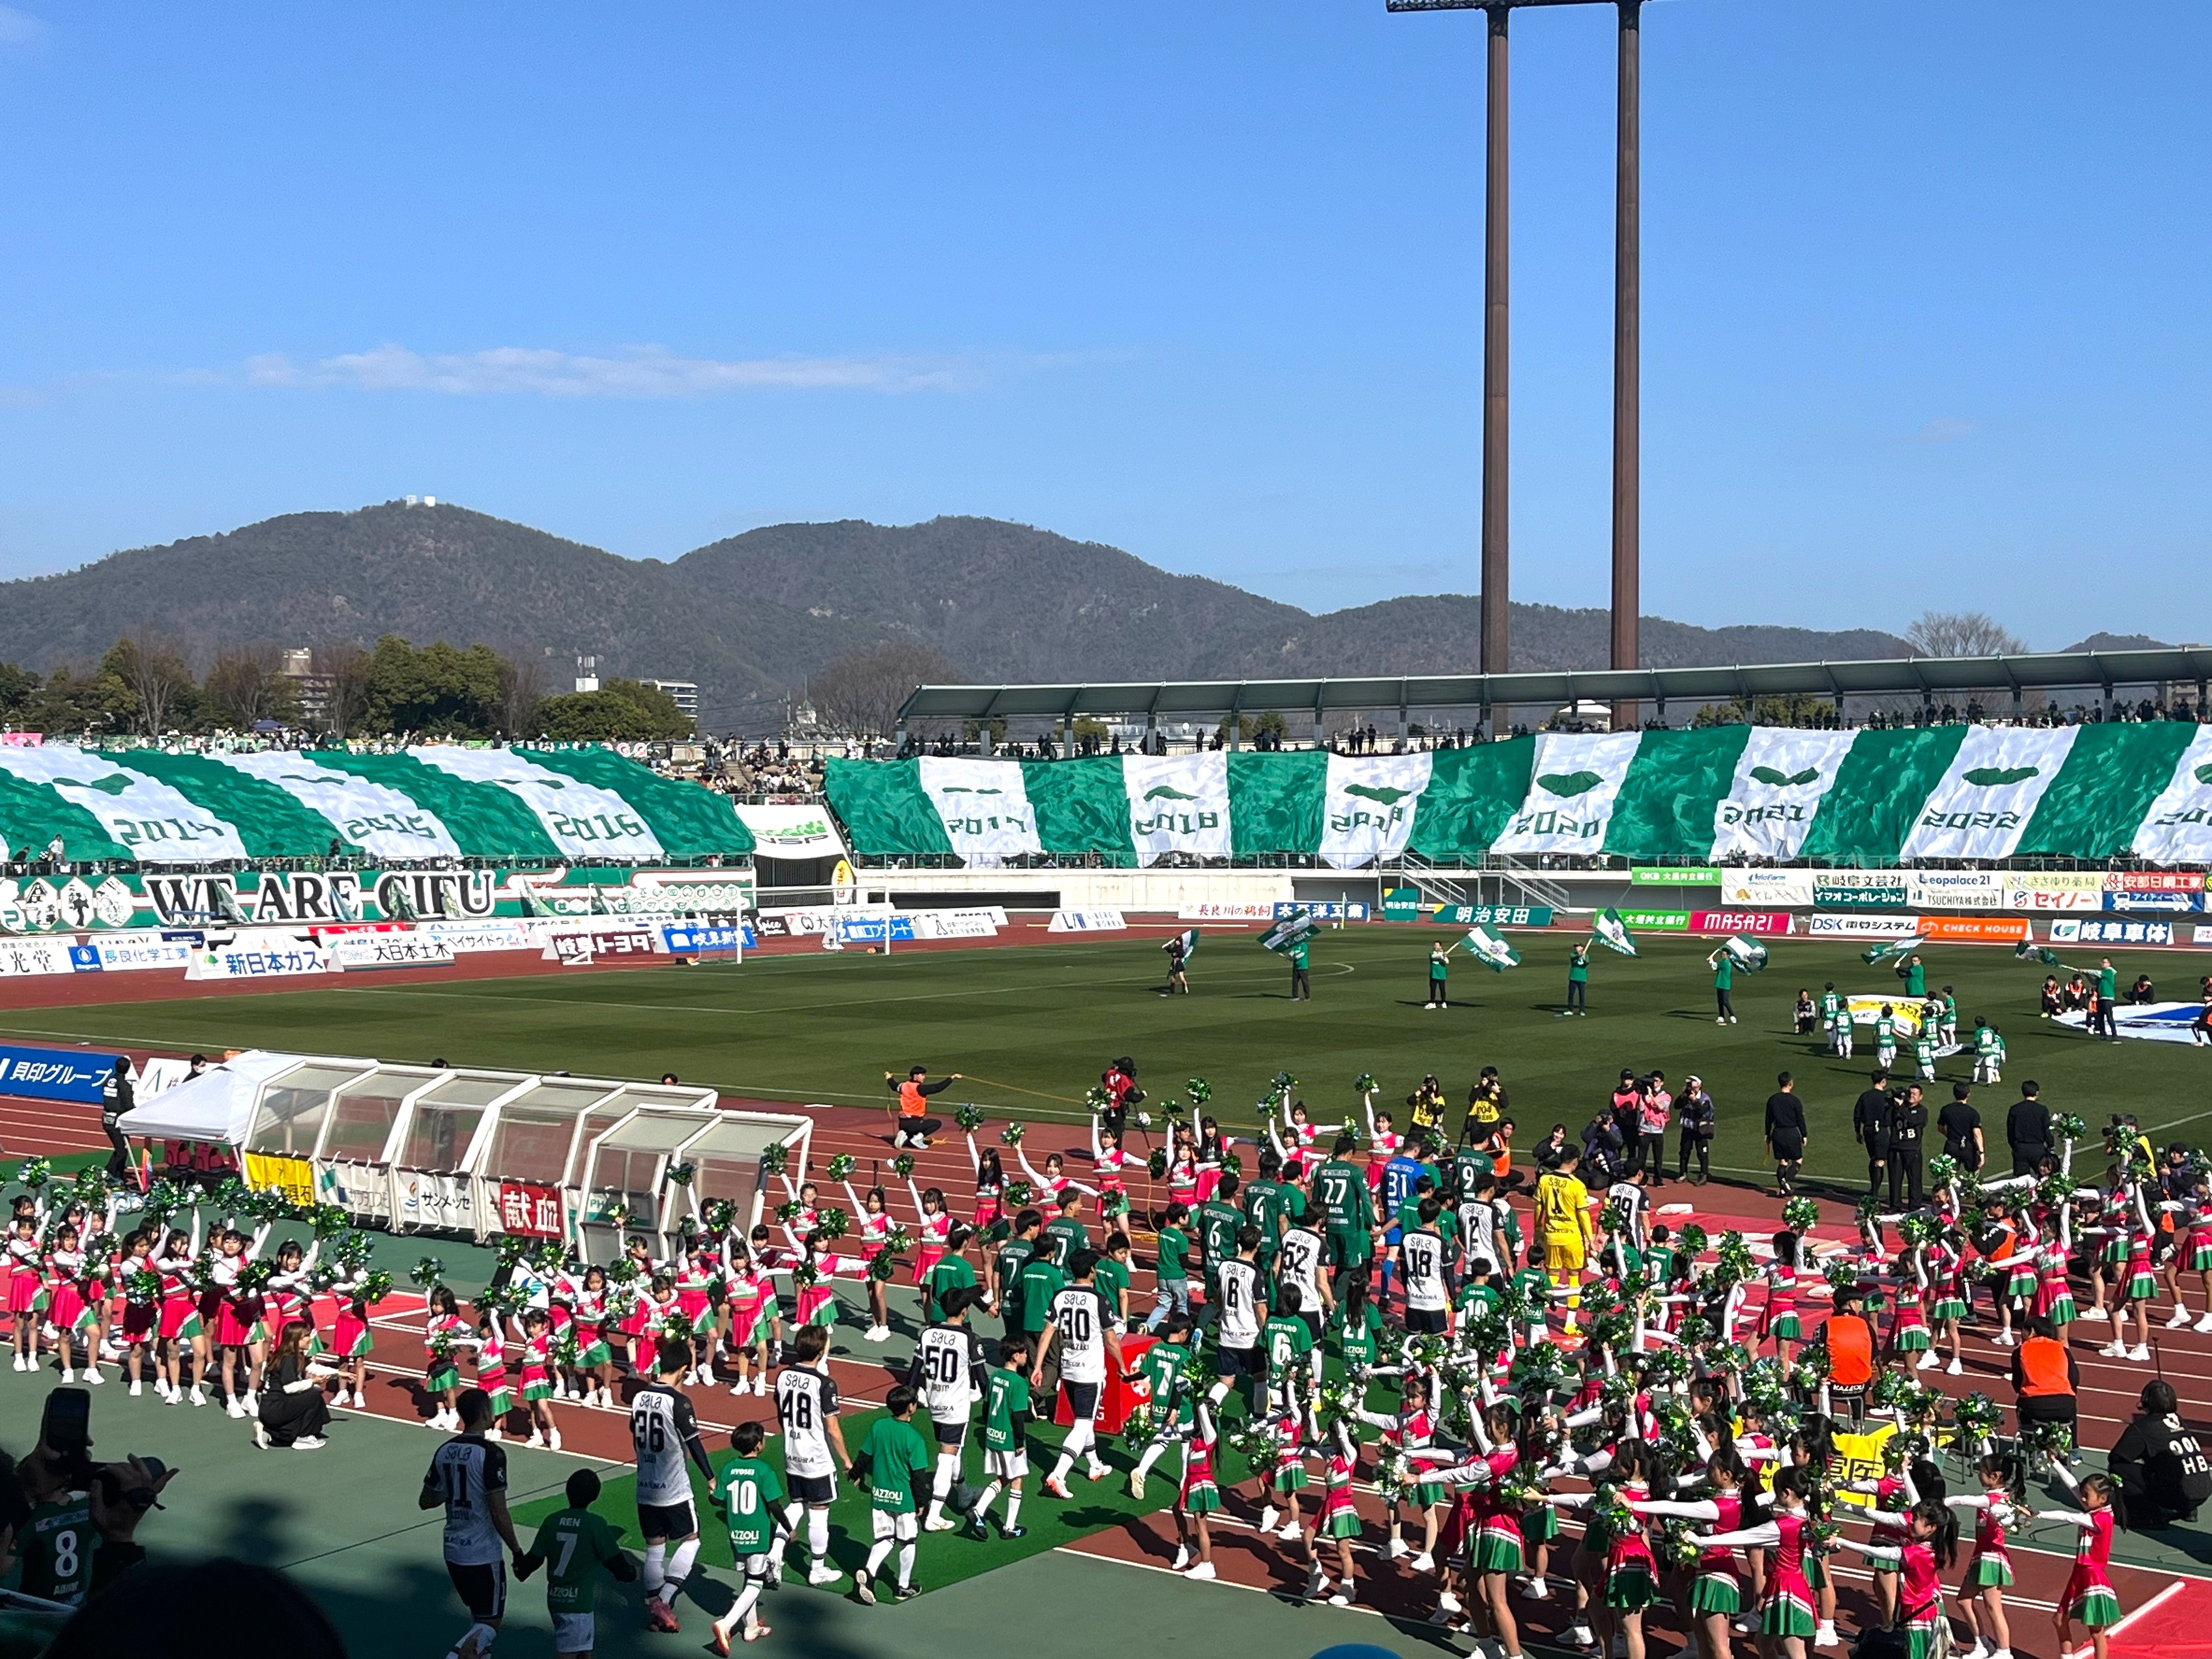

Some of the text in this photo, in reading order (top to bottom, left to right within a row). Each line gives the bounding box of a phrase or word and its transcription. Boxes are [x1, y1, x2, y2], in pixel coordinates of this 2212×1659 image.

[548, 811, 645, 840] 2016
[946, 816, 1027, 835] 2017
[1136, 812, 1218, 836] 2018
[1514, 811, 1600, 838] 2020
[1724, 805, 1807, 825] 2021
[1922, 808, 2021, 830] 2022
[2154, 808, 2212, 826] 20
[113, 818, 224, 845] 2014
[1640, 872, 1660, 881] OKB
[256, 876, 359, 922] ARE
[1386, 901, 1416, 910] 明治安田
[2034, 891, 2093, 909] セイノー
[1455, 907, 1531, 924] 明治安田
[1704, 913, 1773, 931] MASA21
[1812, 918, 1843, 930] DSK
[1943, 923, 2023, 934] CHECK HOUSE
[2082, 922, 2168, 942] 岐阜車体
[104, 947, 189, 964] 長良化学工業
[225, 950, 323, 975] 新日本ガス
[374, 943, 450, 961] 大日本土木
[1879, 1023, 1891, 1036] 10
[9, 1061, 112, 1087] 貝印グループ
[1387, 1172, 1407, 1198] 31
[1463, 1165, 1474, 1190] 9
[421, 1191, 470, 1210] サンメッセ
[1323, 1178, 1347, 1204] 27
[503, 1190, 561, 1233] 献血
[1253, 1196, 1265, 1222] 4
[1209, 1221, 1221, 1248] 6
[1006, 1258, 1018, 1285] 7
[1409, 1248, 1432, 1278] 18
[1059, 1307, 1090, 1341] 30
[1272, 1333, 1291, 1365] 6
[925, 1345, 958, 1383] 50
[1156, 1359, 1173, 1396] 7
[782, 1389, 811, 1429] 48
[991, 1385, 1004, 1416] 7
[635, 1410, 665, 1453] 36
[2181, 1455, 2208, 1475] HB
[442, 1463, 472, 1509] 11
[726, 1479, 757, 1515] 10
[558, 1516, 581, 1527] REN
[55, 1530, 78, 1577] 8
[553, 1532, 578, 1577] 7
